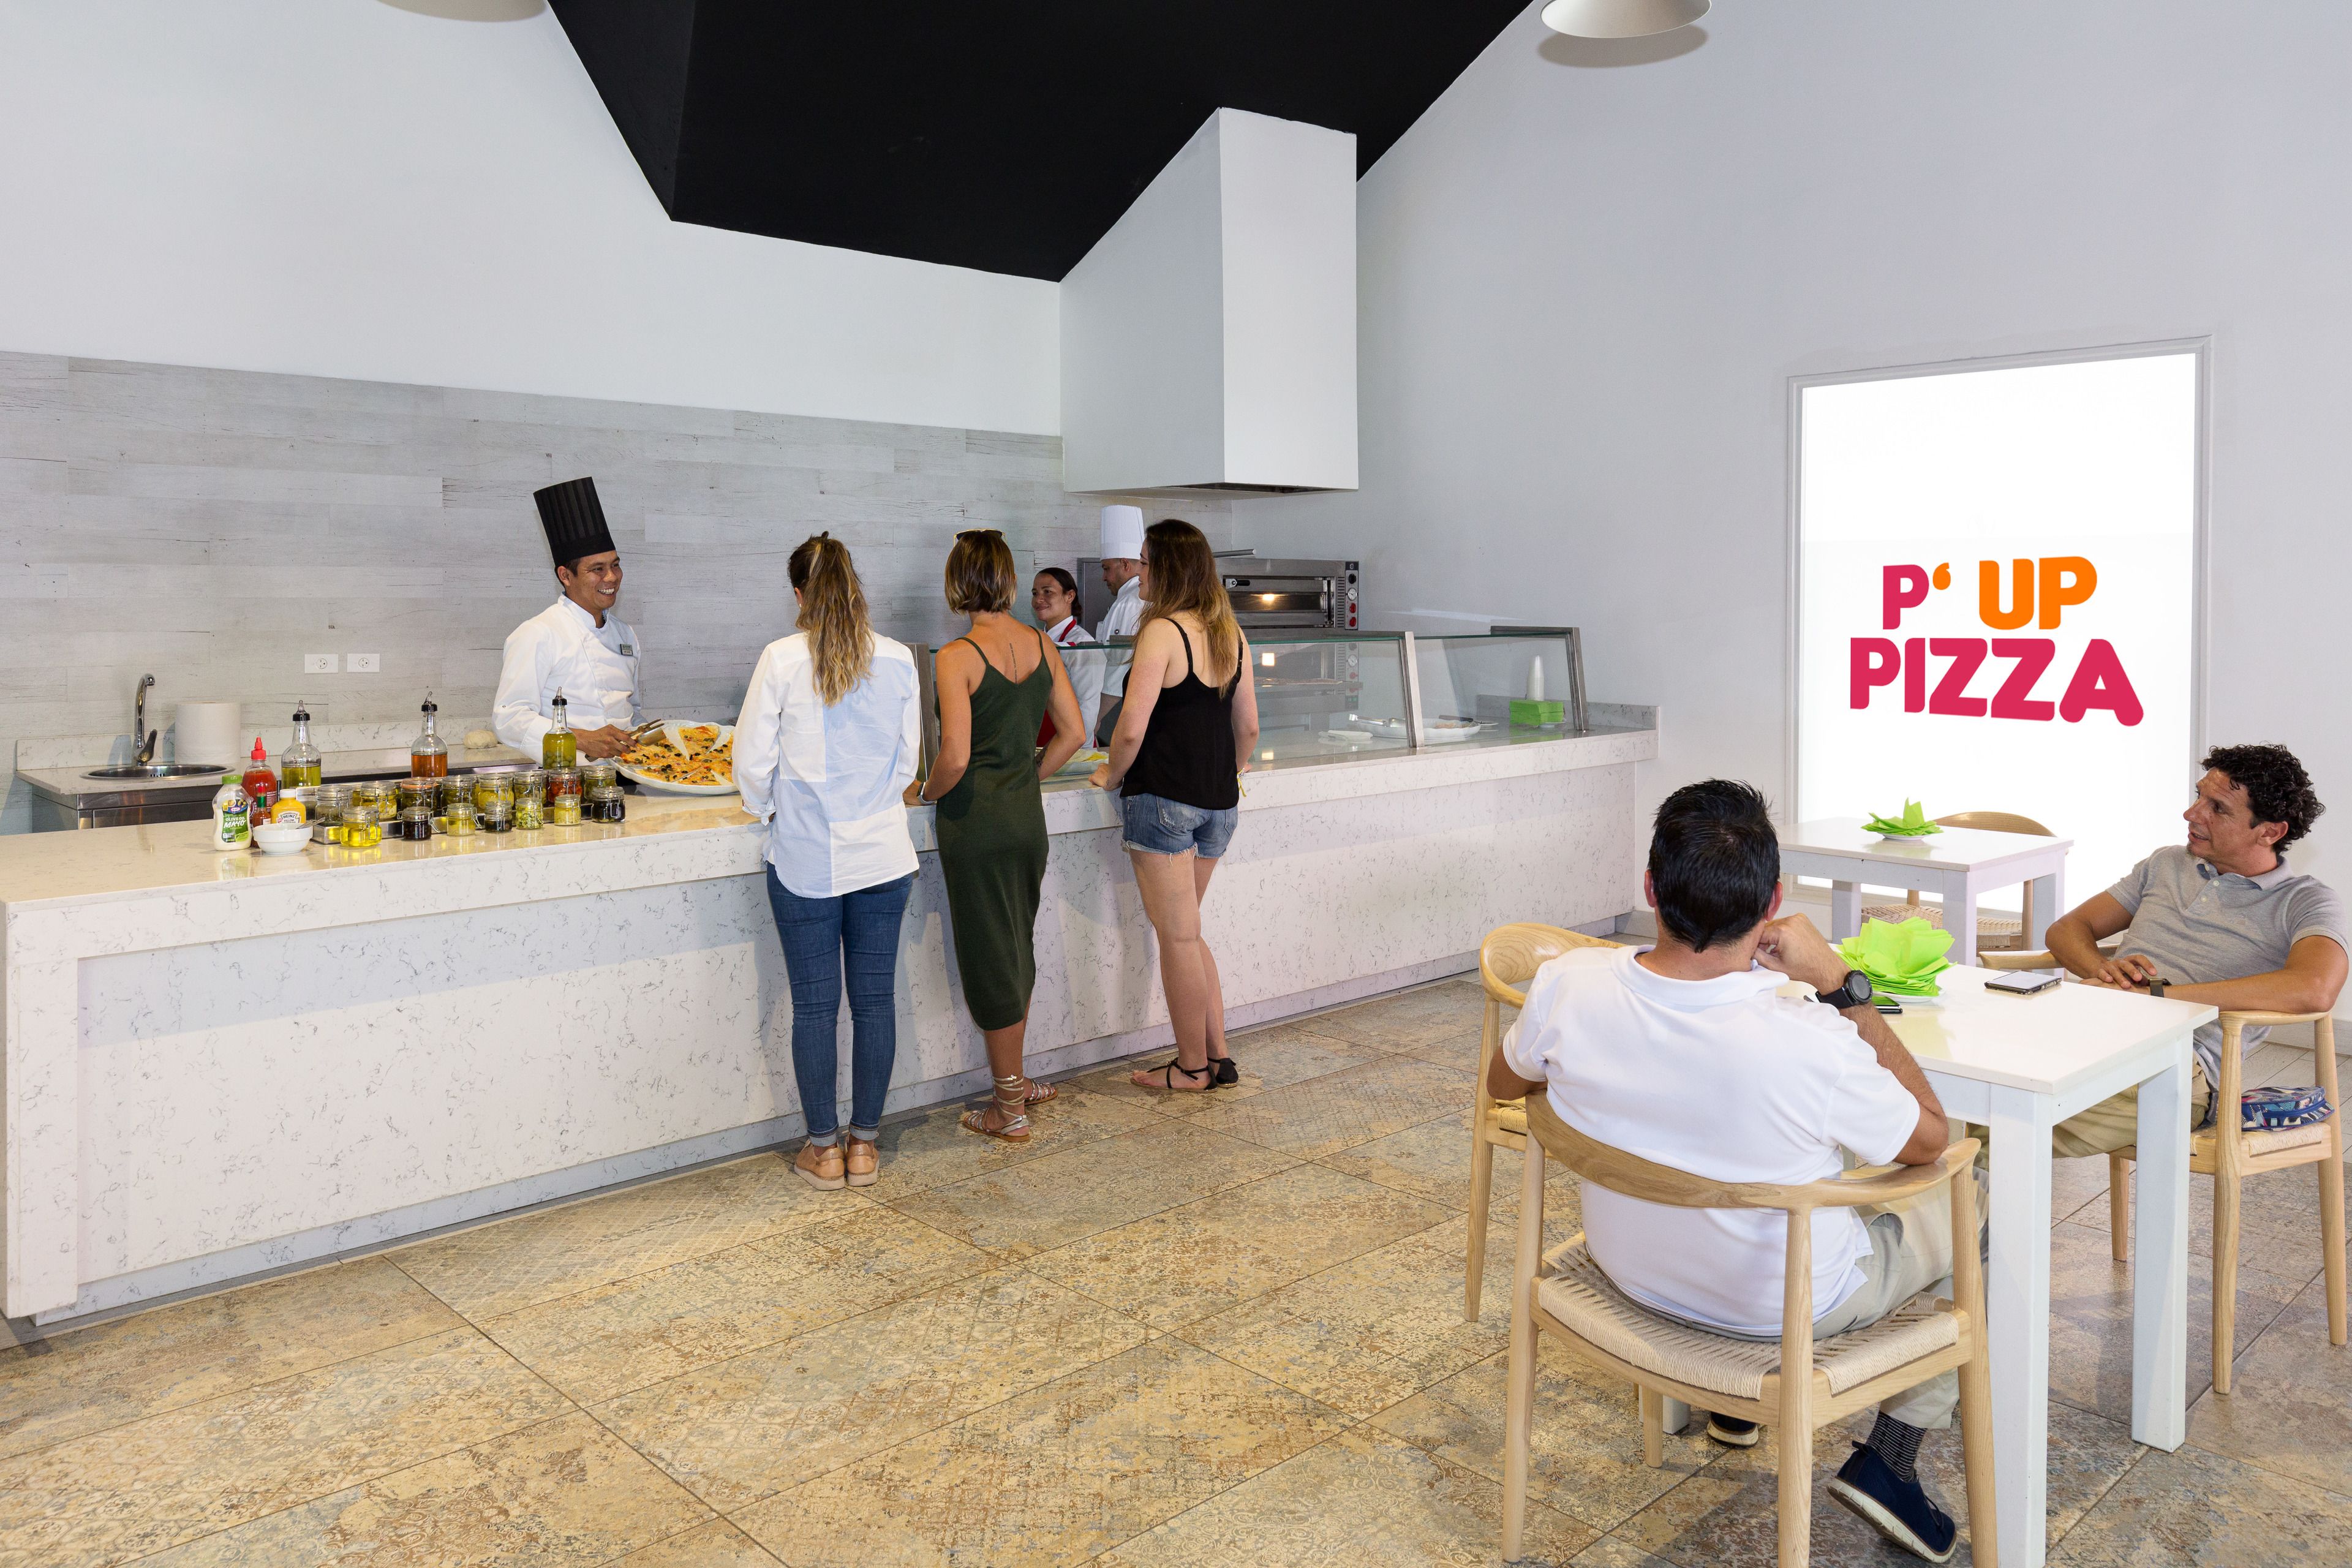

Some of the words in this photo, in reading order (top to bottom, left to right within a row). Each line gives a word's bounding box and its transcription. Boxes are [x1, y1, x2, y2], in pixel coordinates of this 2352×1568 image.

[1979, 556, 2097, 630] UP
[1850, 638, 2144, 727] PIZZA
[224, 820, 246, 828] MAYO
